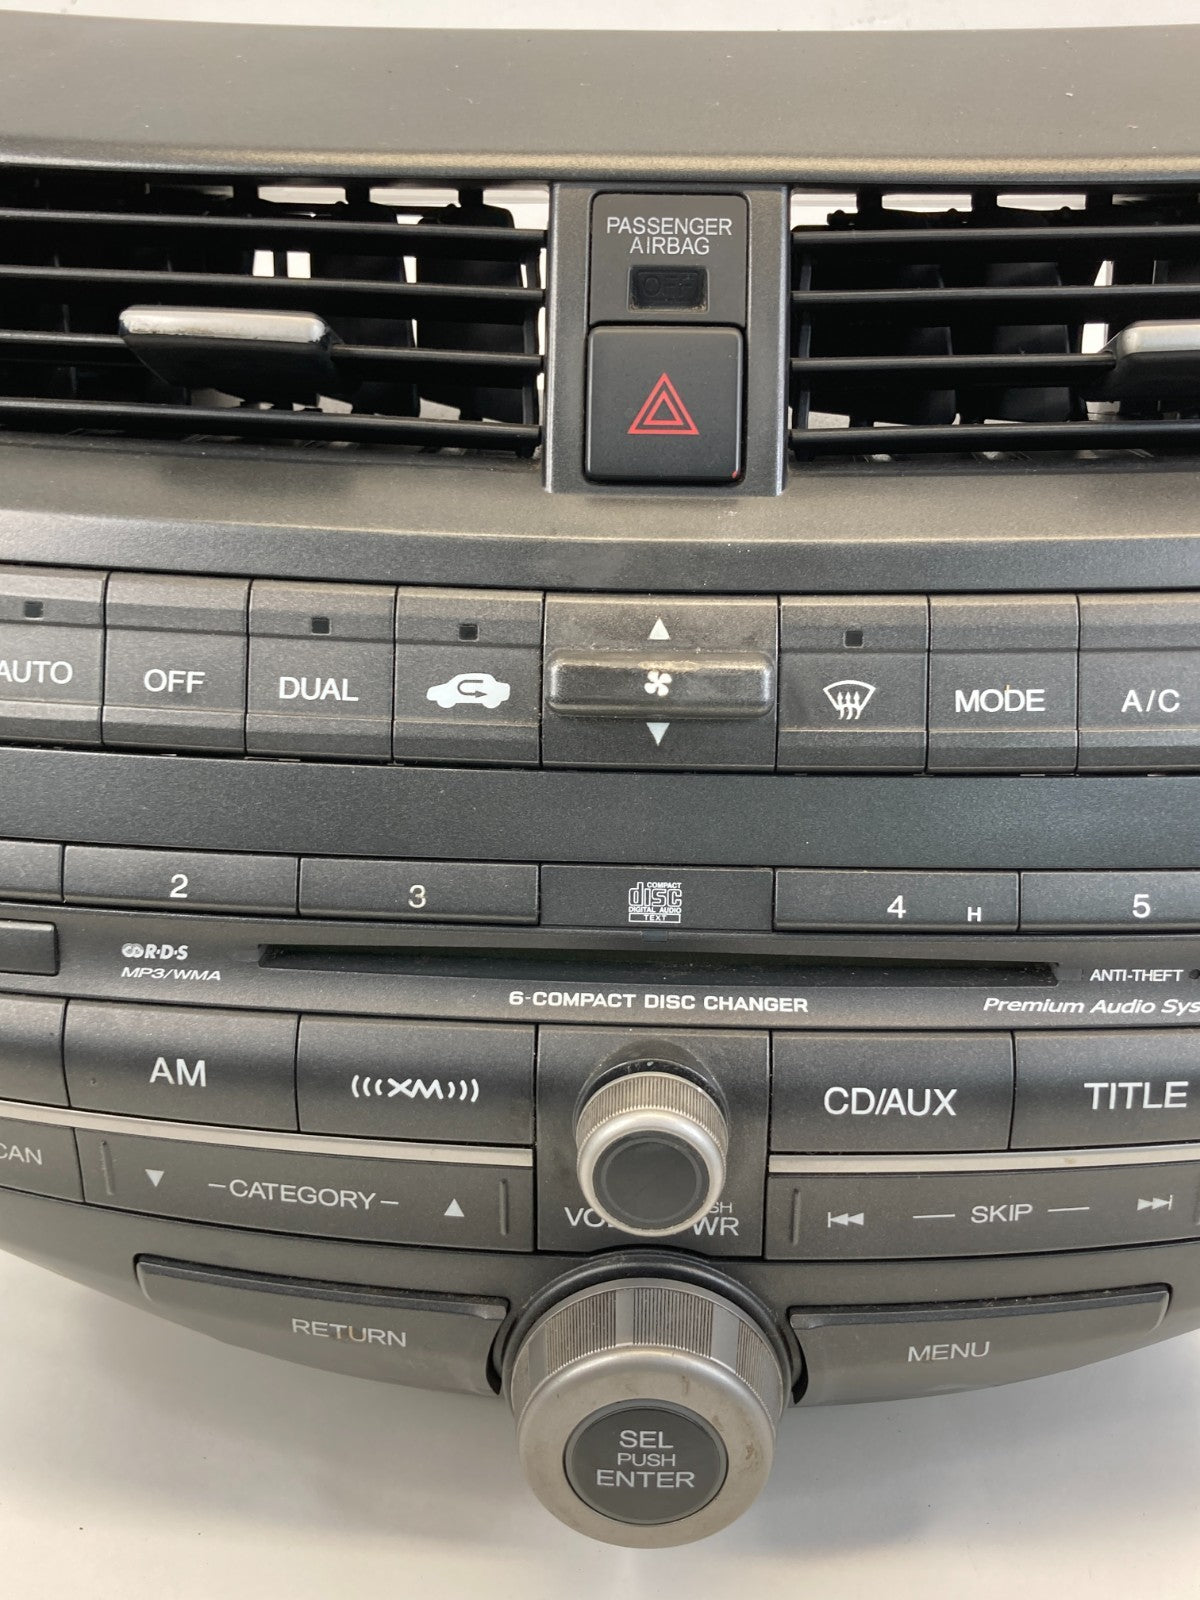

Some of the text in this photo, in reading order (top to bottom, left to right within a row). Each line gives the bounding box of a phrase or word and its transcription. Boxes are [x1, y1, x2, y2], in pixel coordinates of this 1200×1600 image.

[606, 216, 733, 236] PASSENGER
[629, 236, 710, 255] AIRBAG
[0, 659, 73, 684] AUTO
[143, 668, 206, 694] OFF
[278, 676, 359, 702] DUAL
[954, 688, 1046, 713] MODE
[1121, 688, 1181, 713] A/C
[169, 873, 189, 899] 2
[407, 884, 427, 909] 3
[628, 881, 683, 908] disc
[646, 881, 682, 889] COMPACT
[628, 906, 682, 914] DIGITAL AUDIO
[886, 895, 907, 919] 4
[966, 906, 983, 922] H
[1131, 893, 1151, 918] 5
[643, 914, 668, 922] TEXT
[121, 966, 221, 981] MP3/WMA
[1089, 968, 1184, 982] ANTI-THEFT
[508, 990, 809, 1013] 6-COMPACT DISC CHANGER
[983, 997, 1084, 1014] Premium
[1089, 998, 1156, 1014] Audio
[149, 1056, 207, 1087] AM
[823, 1086, 957, 1117] CD/AUX
[1083, 1081, 1189, 1110] TITLE
[228, 1178, 377, 1211] CATEGORY
[563, 1206, 617, 1229] VO
[970, 1203, 1034, 1224] SKIP
[692, 1216, 740, 1237] WR
[291, 1318, 407, 1348] RETURN
[907, 1341, 991, 1363] MENU
[618, 1429, 674, 1449] SEL
[616, 1452, 676, 1467] PUSH
[596, 1468, 696, 1489] ENTER
